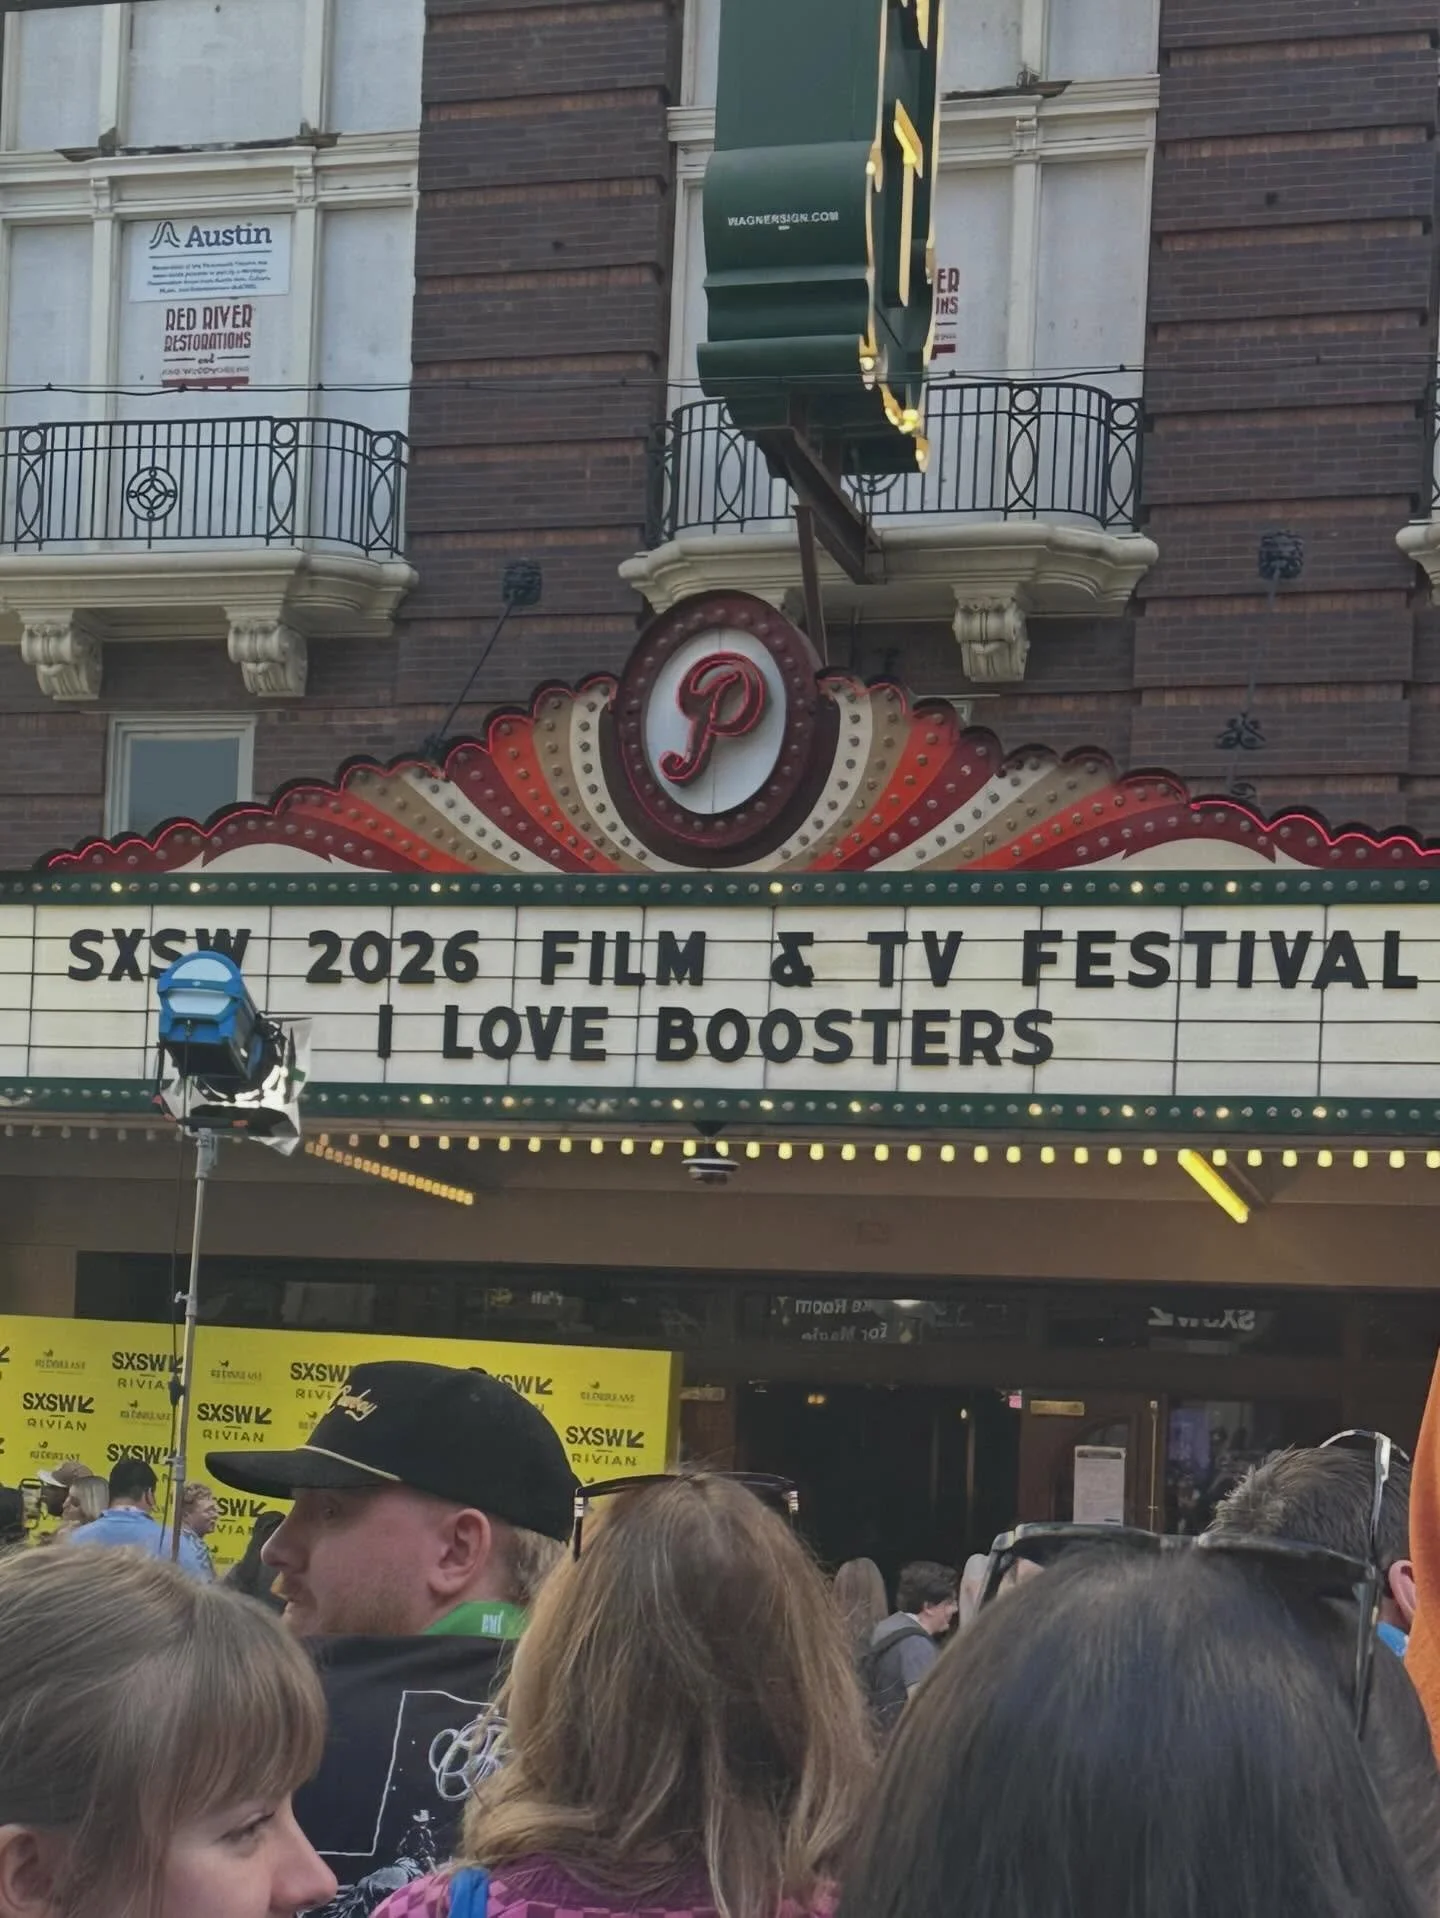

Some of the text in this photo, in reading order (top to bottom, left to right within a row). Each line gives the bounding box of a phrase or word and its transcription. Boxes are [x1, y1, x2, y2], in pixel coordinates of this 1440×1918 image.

[184, 223, 272, 248] Austin
[165, 304, 253, 331] RED RIVER
[164, 331, 251, 352] RESTORATIONS
[306, 929, 479, 984] 2026
[541, 930, 706, 986] FILM
[770, 931, 814, 988] &
[867, 930, 964, 989] TV
[1022, 929, 1419, 990] FESTIVAL
[377, 1004, 1054, 1066] I LOVE BOOSTERS
[112, 1352, 166, 1372] SXSW
[290, 1362, 346, 1382] SXSW
[118, 1378, 165, 1390] RIVIA
[295, 1388, 331, 1400] RIVI
[22, 1392, 76, 1413] SXSW
[197, 1402, 253, 1424] SXSW
[27, 1418, 87, 1431] RIVIAN
[202, 1429, 265, 1443] RIVIAN
[566, 1426, 625, 1447] SXSW
[571, 1453, 637, 1467] RIVIAN
[214, 1497, 247, 1516] SW
